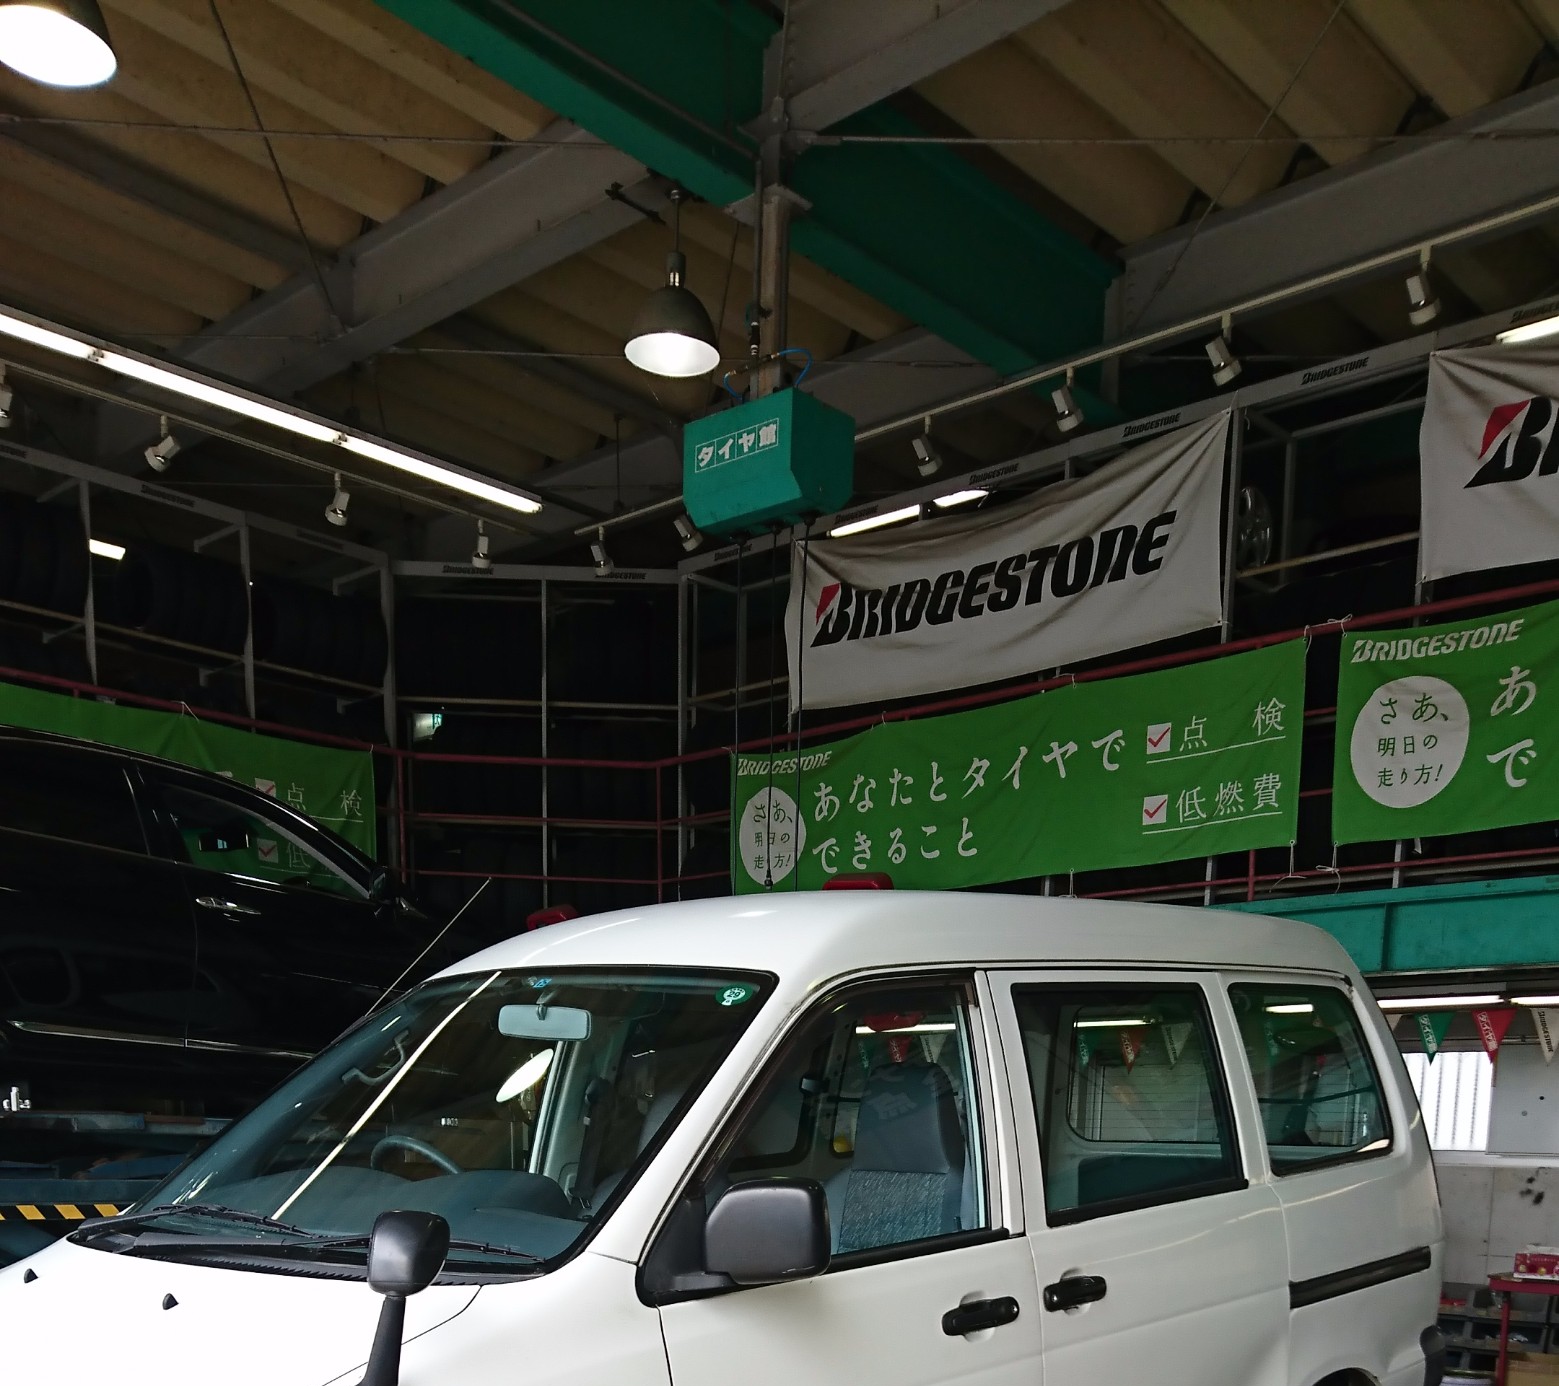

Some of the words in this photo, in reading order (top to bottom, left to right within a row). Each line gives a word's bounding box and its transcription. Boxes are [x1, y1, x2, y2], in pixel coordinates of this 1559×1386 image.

[1301, 357, 1369, 385] BRIDGESTONE
[698, 423, 777, 468] タイヤ館
[1122, 413, 1181, 437] BRIDGESTONE
[810, 509, 1178, 648] BRIDGESTONE
[1350, 618, 1525, 664] BRIDGESTONE
[1379, 692, 1449, 725] さあ、
[1490, 665, 1537, 717] あ
[737, 750, 833, 777] BRIDGESTONE
[1377, 734, 1438, 758] 明日の
[1486, 738, 1537, 788] で
[813, 729, 1126, 823] あなたとタイヤで
[1175, 772, 1282, 824] 低燃費
[753, 853, 792, 870] 走方!
[812, 816, 979, 874] できること
